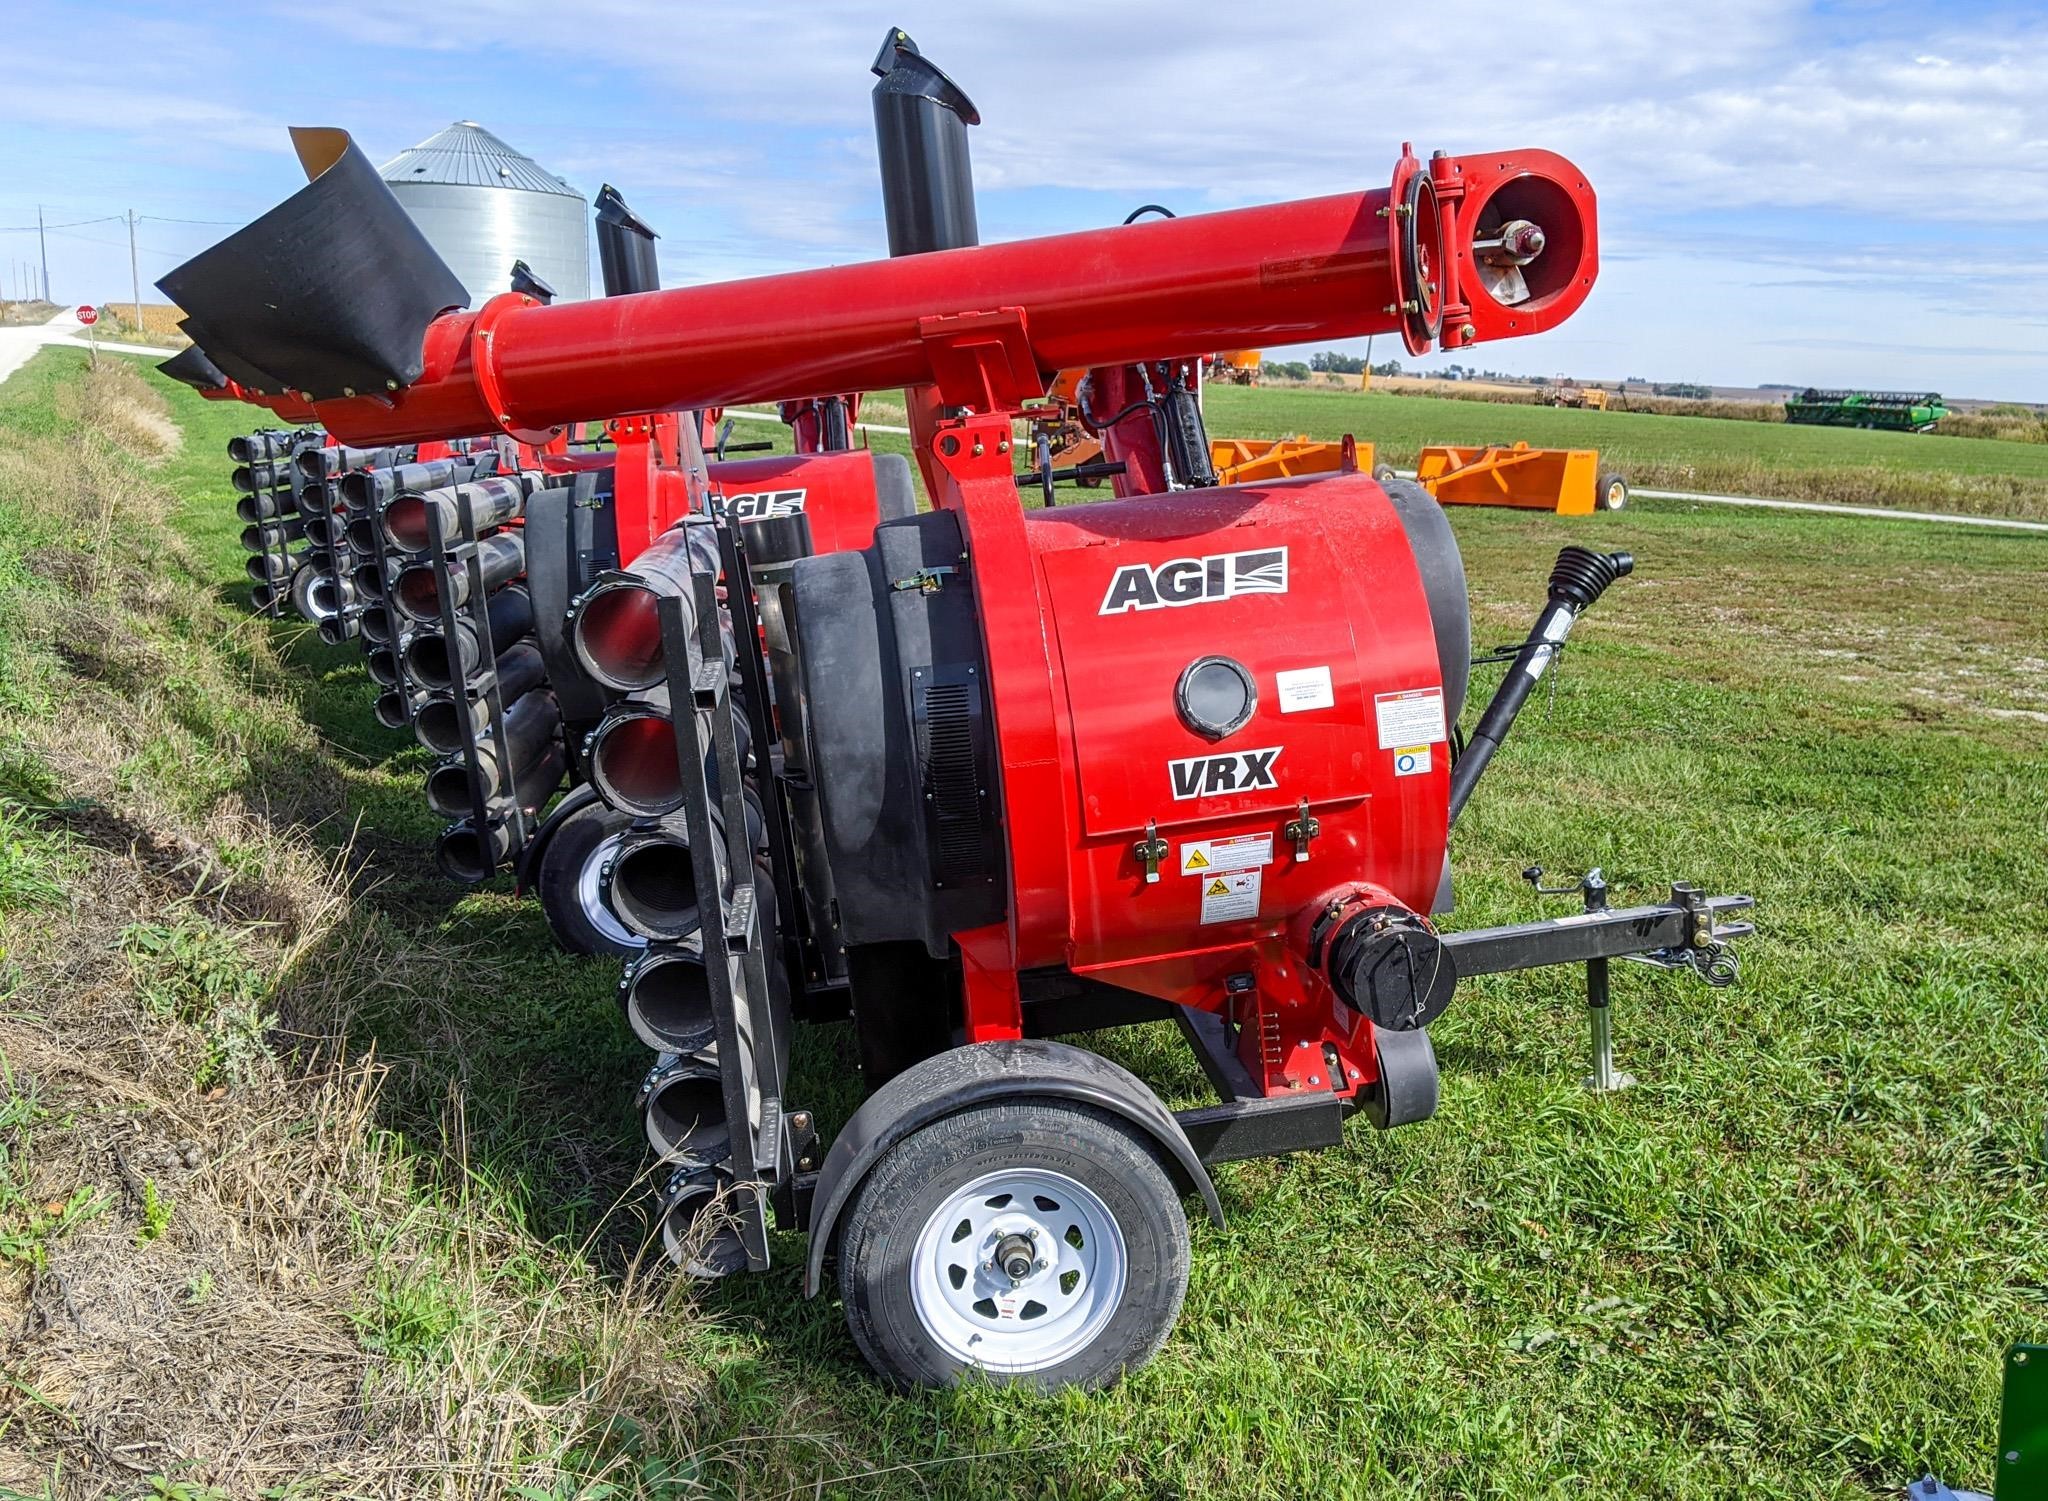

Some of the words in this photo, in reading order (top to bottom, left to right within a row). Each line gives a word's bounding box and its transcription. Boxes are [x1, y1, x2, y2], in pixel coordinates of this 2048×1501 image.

[77, 310, 96, 320] STOP
[1105, 557, 1226, 610] AGI
[1405, 746, 1427, 754] CAUTION
[1172, 751, 1276, 796] VRX
